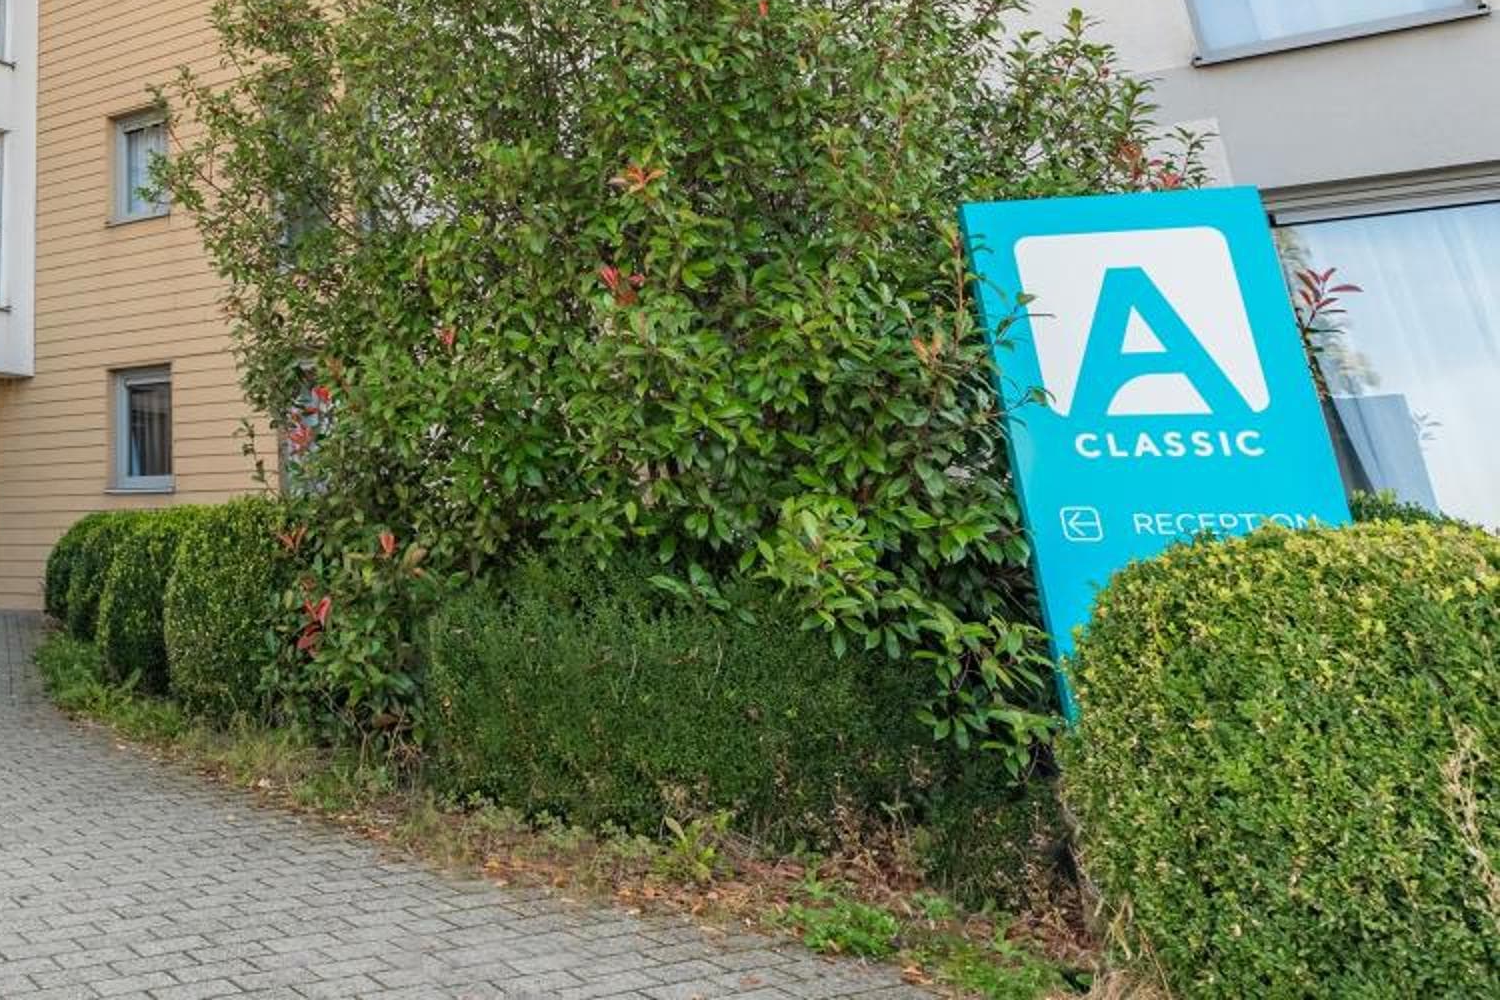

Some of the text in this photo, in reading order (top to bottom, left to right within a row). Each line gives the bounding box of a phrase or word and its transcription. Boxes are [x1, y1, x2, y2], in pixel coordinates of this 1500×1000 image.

[1069, 266, 1254, 416] A
[1075, 430, 1266, 458] CLASSIC
[1132, 512, 1318, 536] RECEPTON
